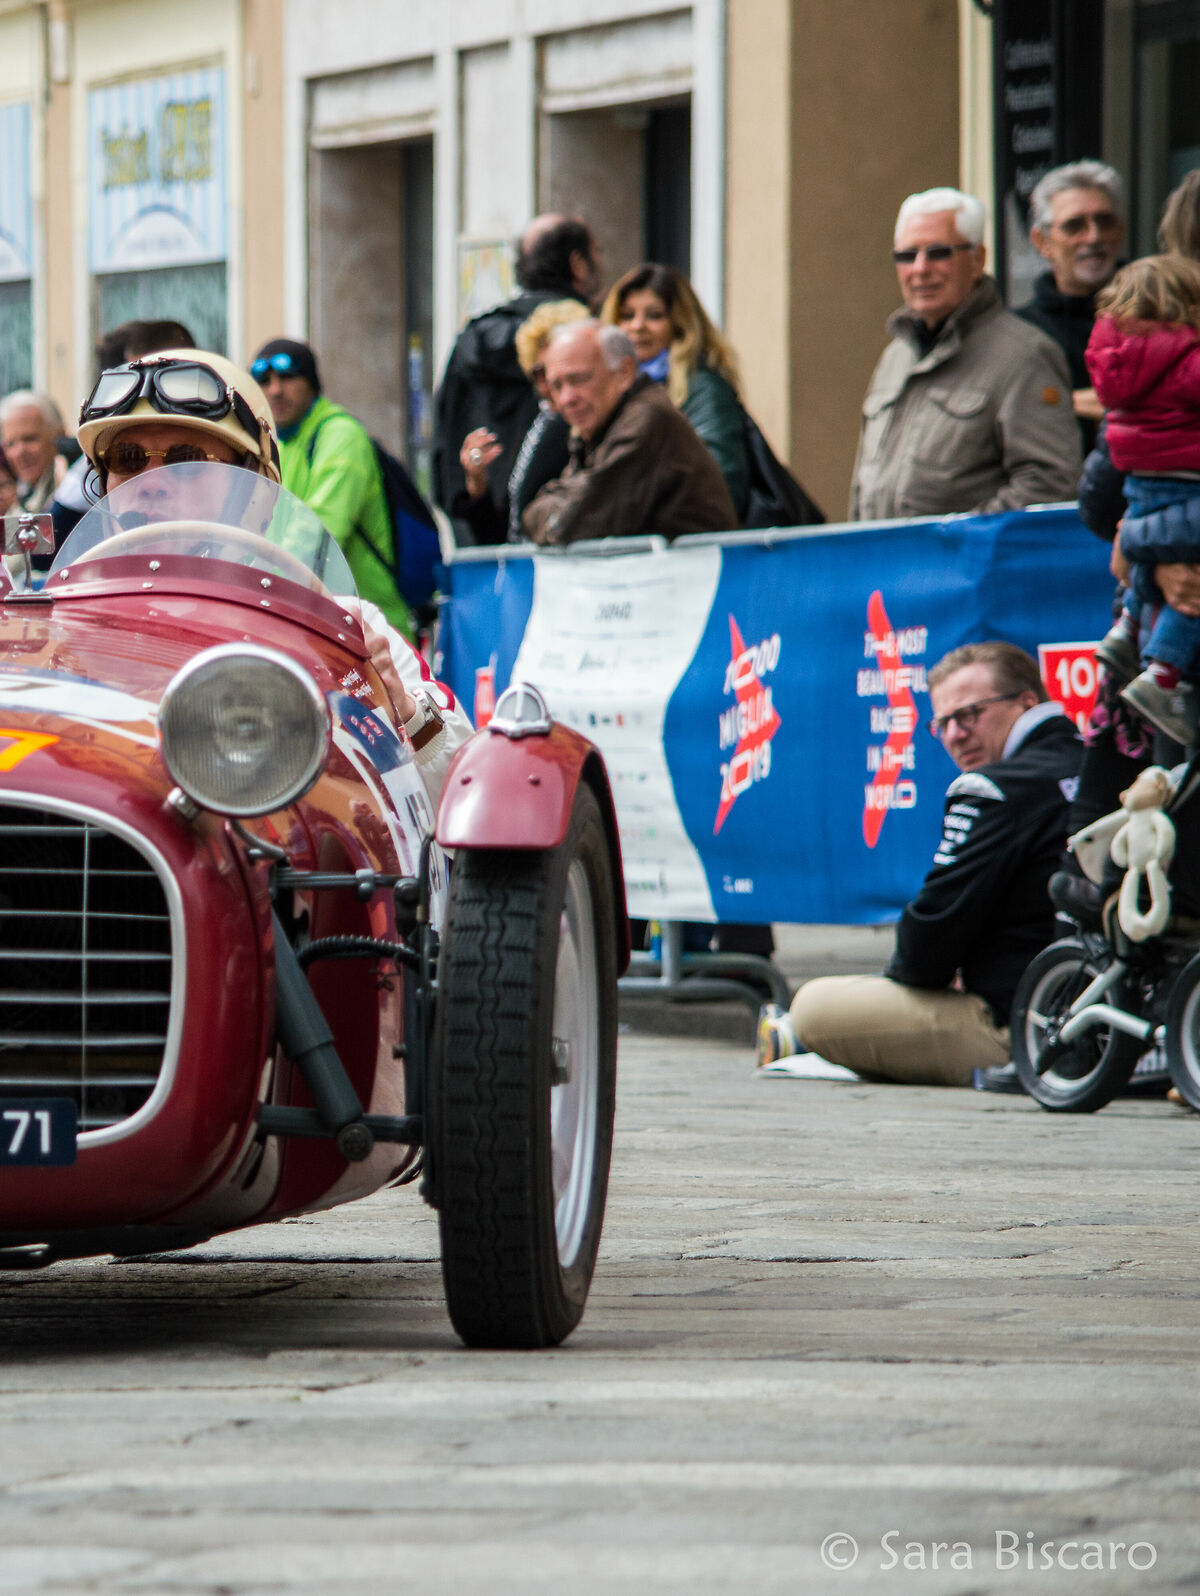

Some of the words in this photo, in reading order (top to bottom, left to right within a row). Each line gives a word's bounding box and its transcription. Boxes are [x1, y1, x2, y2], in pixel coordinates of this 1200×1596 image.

[897, 627, 928, 656] MOST
[723, 632, 782, 695] 1000
[1056, 656, 1105, 699] 10
[857, 666, 928, 697] BEAUTIFUL
[719, 686, 774, 751] MIGLIA
[870, 706, 914, 734] RACE
[720, 739, 772, 803] 2019
[866, 743, 881, 772] IN
[864, 781, 918, 811] WORLD
